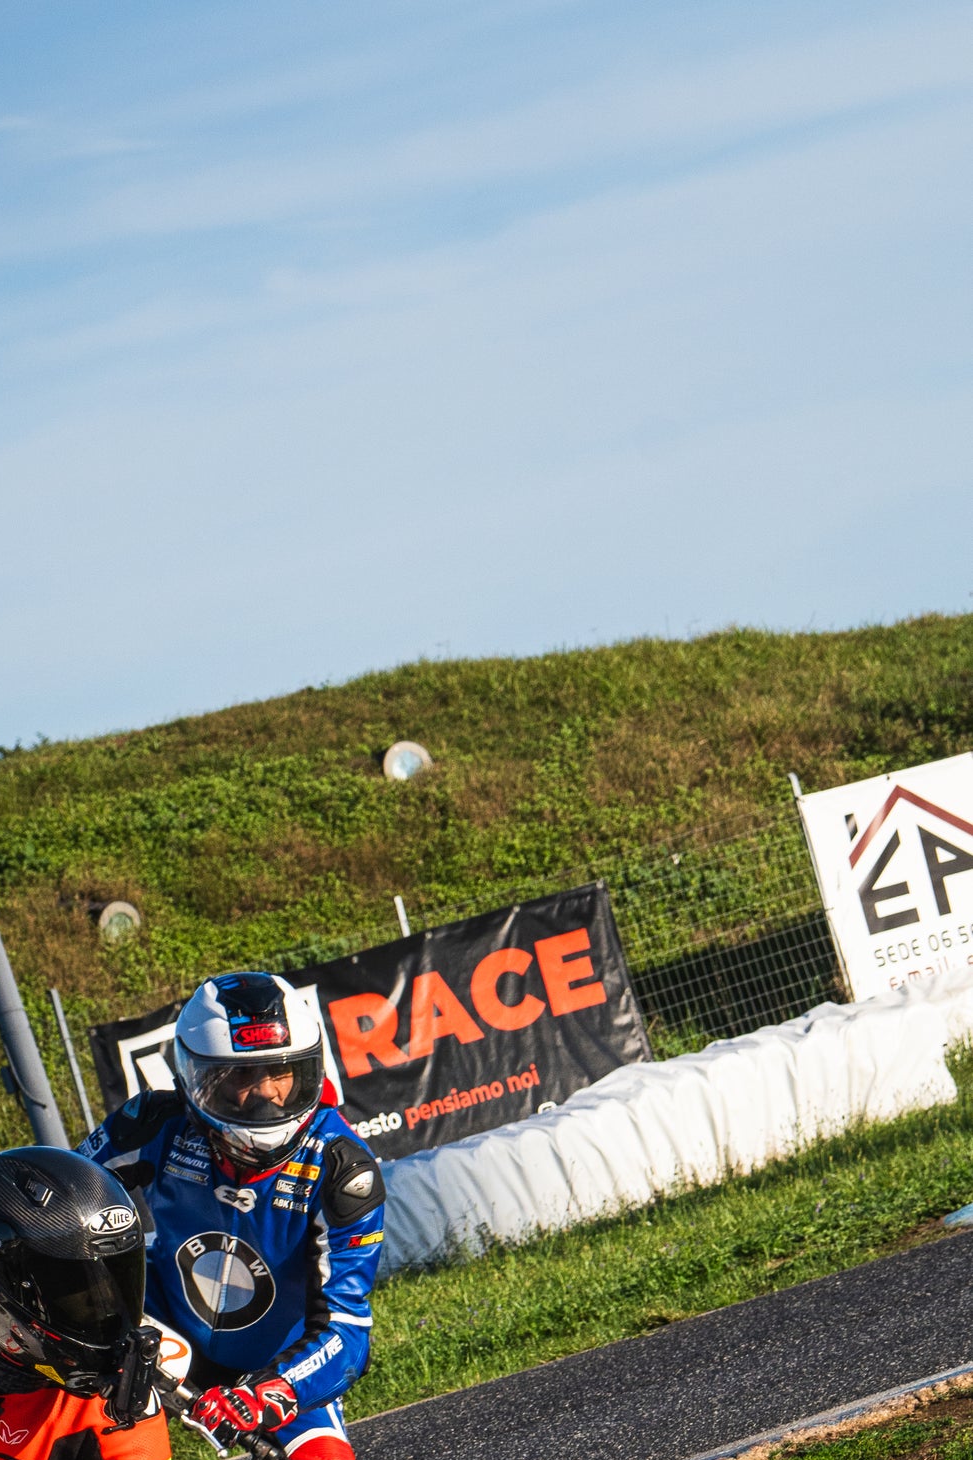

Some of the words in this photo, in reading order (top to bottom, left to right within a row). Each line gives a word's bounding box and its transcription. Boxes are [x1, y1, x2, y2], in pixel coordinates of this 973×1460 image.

[874, 939, 922, 968] SEDE
[928, 931, 953, 952] 06
[958, 924, 973, 944] 5
[329, 928, 607, 1079] RACE
[404, 1080, 504, 1131] pensiamo
[506, 1063, 541, 1094] noi
[98, 1211, 131, 1231] X-lite
[185, 1236, 268, 1277] BMW
